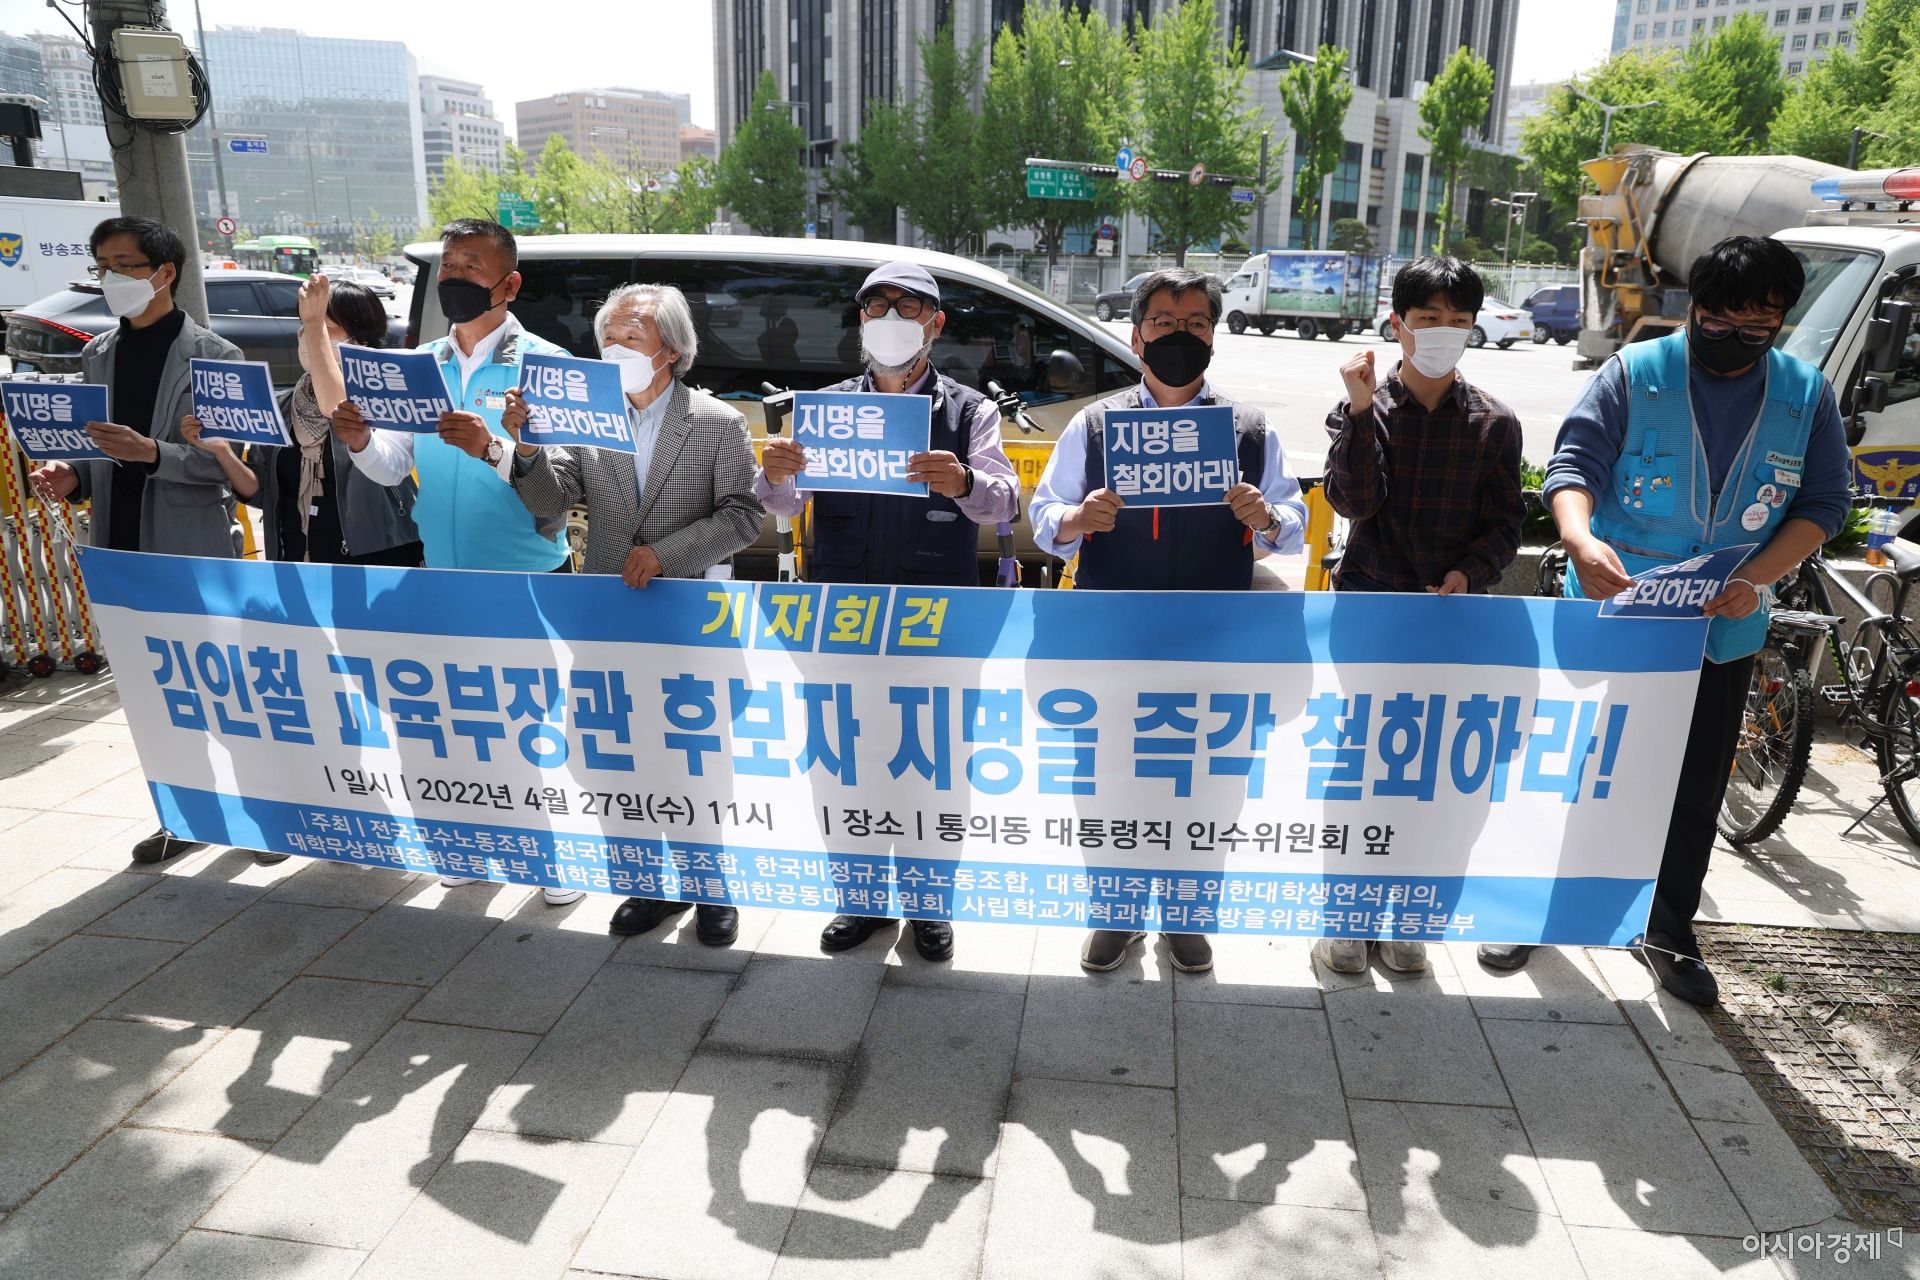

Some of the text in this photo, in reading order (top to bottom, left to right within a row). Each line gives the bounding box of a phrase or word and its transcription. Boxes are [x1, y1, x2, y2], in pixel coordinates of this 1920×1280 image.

[1133, 162, 1143, 174] 50
[194, 369, 245, 401] 지명을
[344, 357, 408, 391] 지명을
[521, 364, 590, 403] 지명을
[7, 392, 73, 422] 지명을
[797, 404, 886, 440] 지명을
[18, 427, 99, 452] 철회하
[1111, 419, 1199, 455] 지명을
[802, 446, 923, 481] 철회하라
[701, 591, 949, 647] 기자회견
[145, 636, 1629, 804] 김인철 교육부장관 후보자 지명을 즉각 철회하라!
[341, 769, 1394, 855] 일시 2022년 4월 27일(수) 11시 장소 통의동 대통령직 인수위원회 앞
[311, 812, 1443, 910] 주최 전국교수노동조합, 전국대학노동조합, 한국비정규교수노동조합, 대학민주화를위한대학생연석회의,
[285, 832, 1475, 935] 대학무상화평준화운동본부, 대학공공성강화를위한공동대책위원회, 사립학교개혁과비리추방을위한국민운동본부
